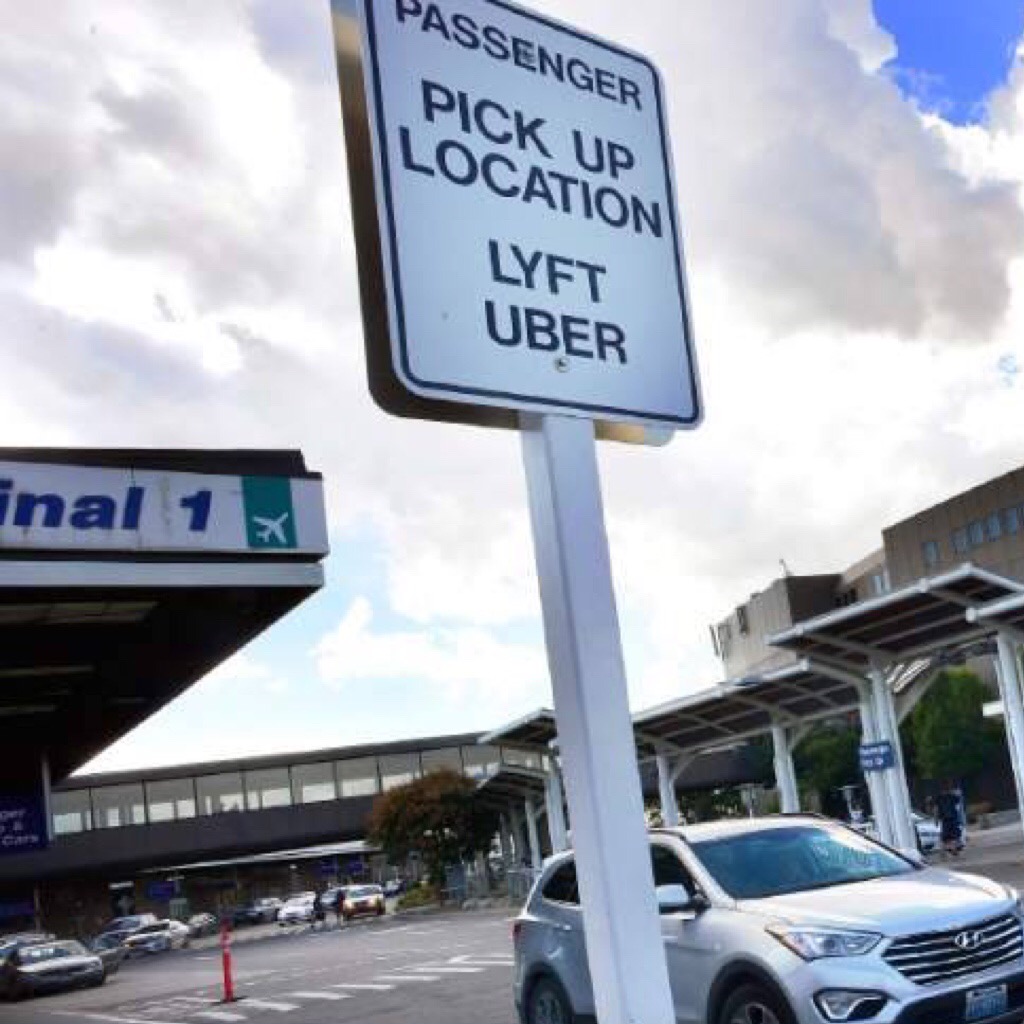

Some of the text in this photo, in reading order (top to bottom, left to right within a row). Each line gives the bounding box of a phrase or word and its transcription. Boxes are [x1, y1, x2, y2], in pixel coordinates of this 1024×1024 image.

[395, 0, 643, 111] PASSENGER
[420, 79, 635, 180] PICK UP
[399, 126, 664, 238] LOCATION
[487, 239, 607, 303] LYFT
[485, 300, 628, 365] UBER
[180, 490, 213, 532] 1
